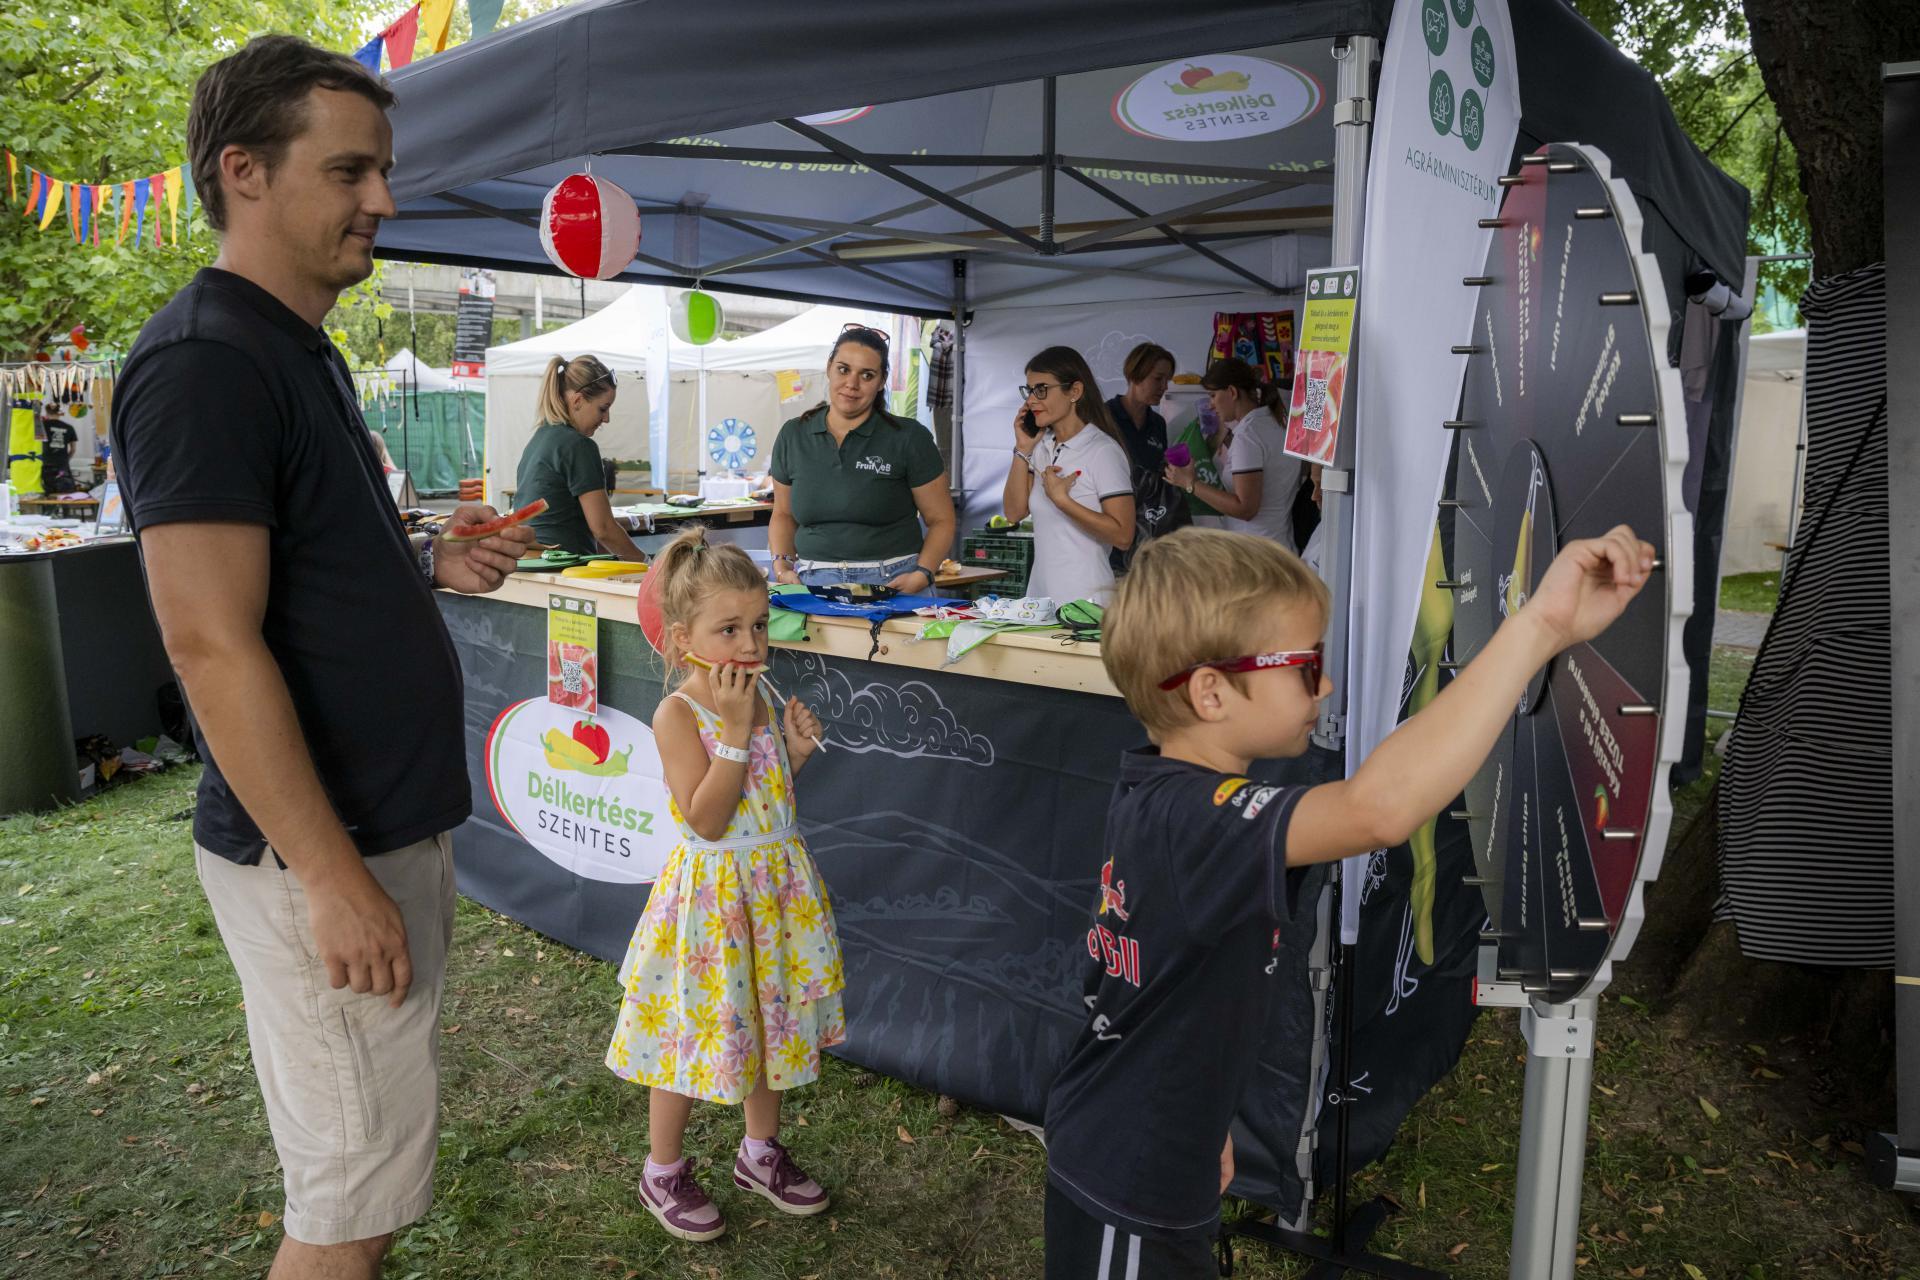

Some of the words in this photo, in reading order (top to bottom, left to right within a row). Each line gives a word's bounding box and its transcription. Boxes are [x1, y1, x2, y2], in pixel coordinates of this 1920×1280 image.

[1556, 224, 1573, 319] Pörgesd
[1575, 323, 1616, 437] gyümölcsöt!
[1595, 349, 1621, 419] Kóstolj
[1256, 654, 1291, 667] DVSC
[1579, 707, 1586, 723] a
[1584, 718, 1595, 746] fel
[1593, 734, 1621, 799] Készülj
[527, 770, 655, 836] Délkertész
[538, 809, 632, 858] SZENTES
